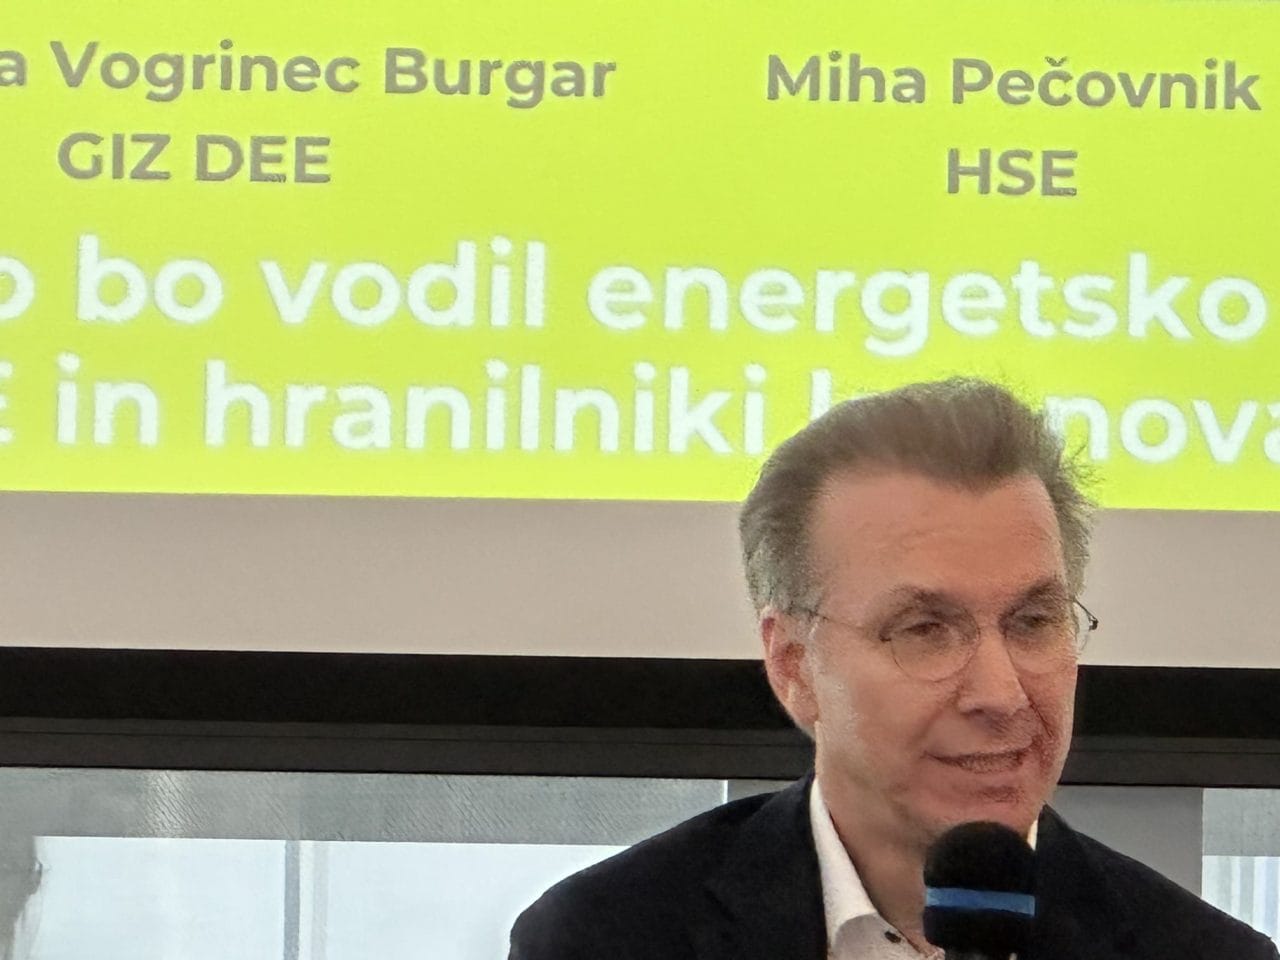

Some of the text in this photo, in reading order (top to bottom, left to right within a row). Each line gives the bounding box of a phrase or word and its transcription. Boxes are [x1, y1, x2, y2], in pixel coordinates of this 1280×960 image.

[50, 40, 360, 102] Vogrinec
[384, 48, 617, 109] Burgar
[767, 50, 1262, 111] Miha Pečovnik
[57, 132, 331, 184] GIZ DEE
[947, 148, 1078, 196] HSE
[76, 234, 225, 325] bo
[260, 236, 546, 329] vodil
[587, 252, 1268, 357] energetsko
[56, 352, 161, 448] in
[204, 359, 767, 457] hranilniki
